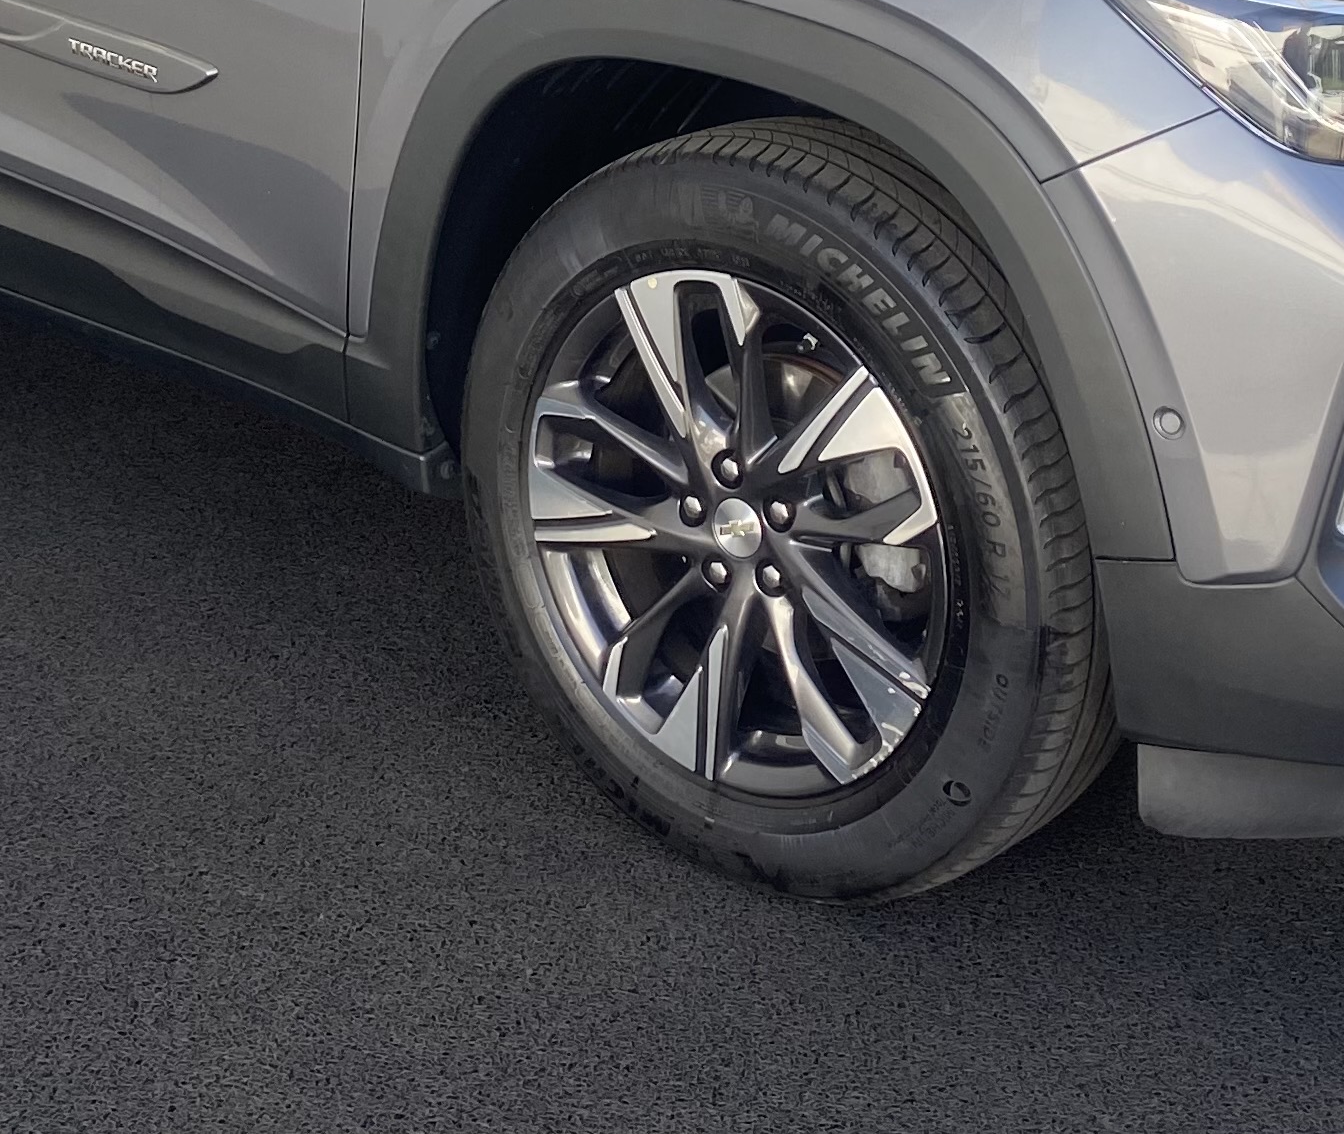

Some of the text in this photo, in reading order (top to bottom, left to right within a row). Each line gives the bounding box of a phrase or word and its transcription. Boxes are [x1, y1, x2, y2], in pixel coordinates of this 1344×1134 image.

[67, 36, 158, 84] TRACKER
[766, 213, 952, 386] MICHELIN
[951, 421, 1002, 528] 215/60
